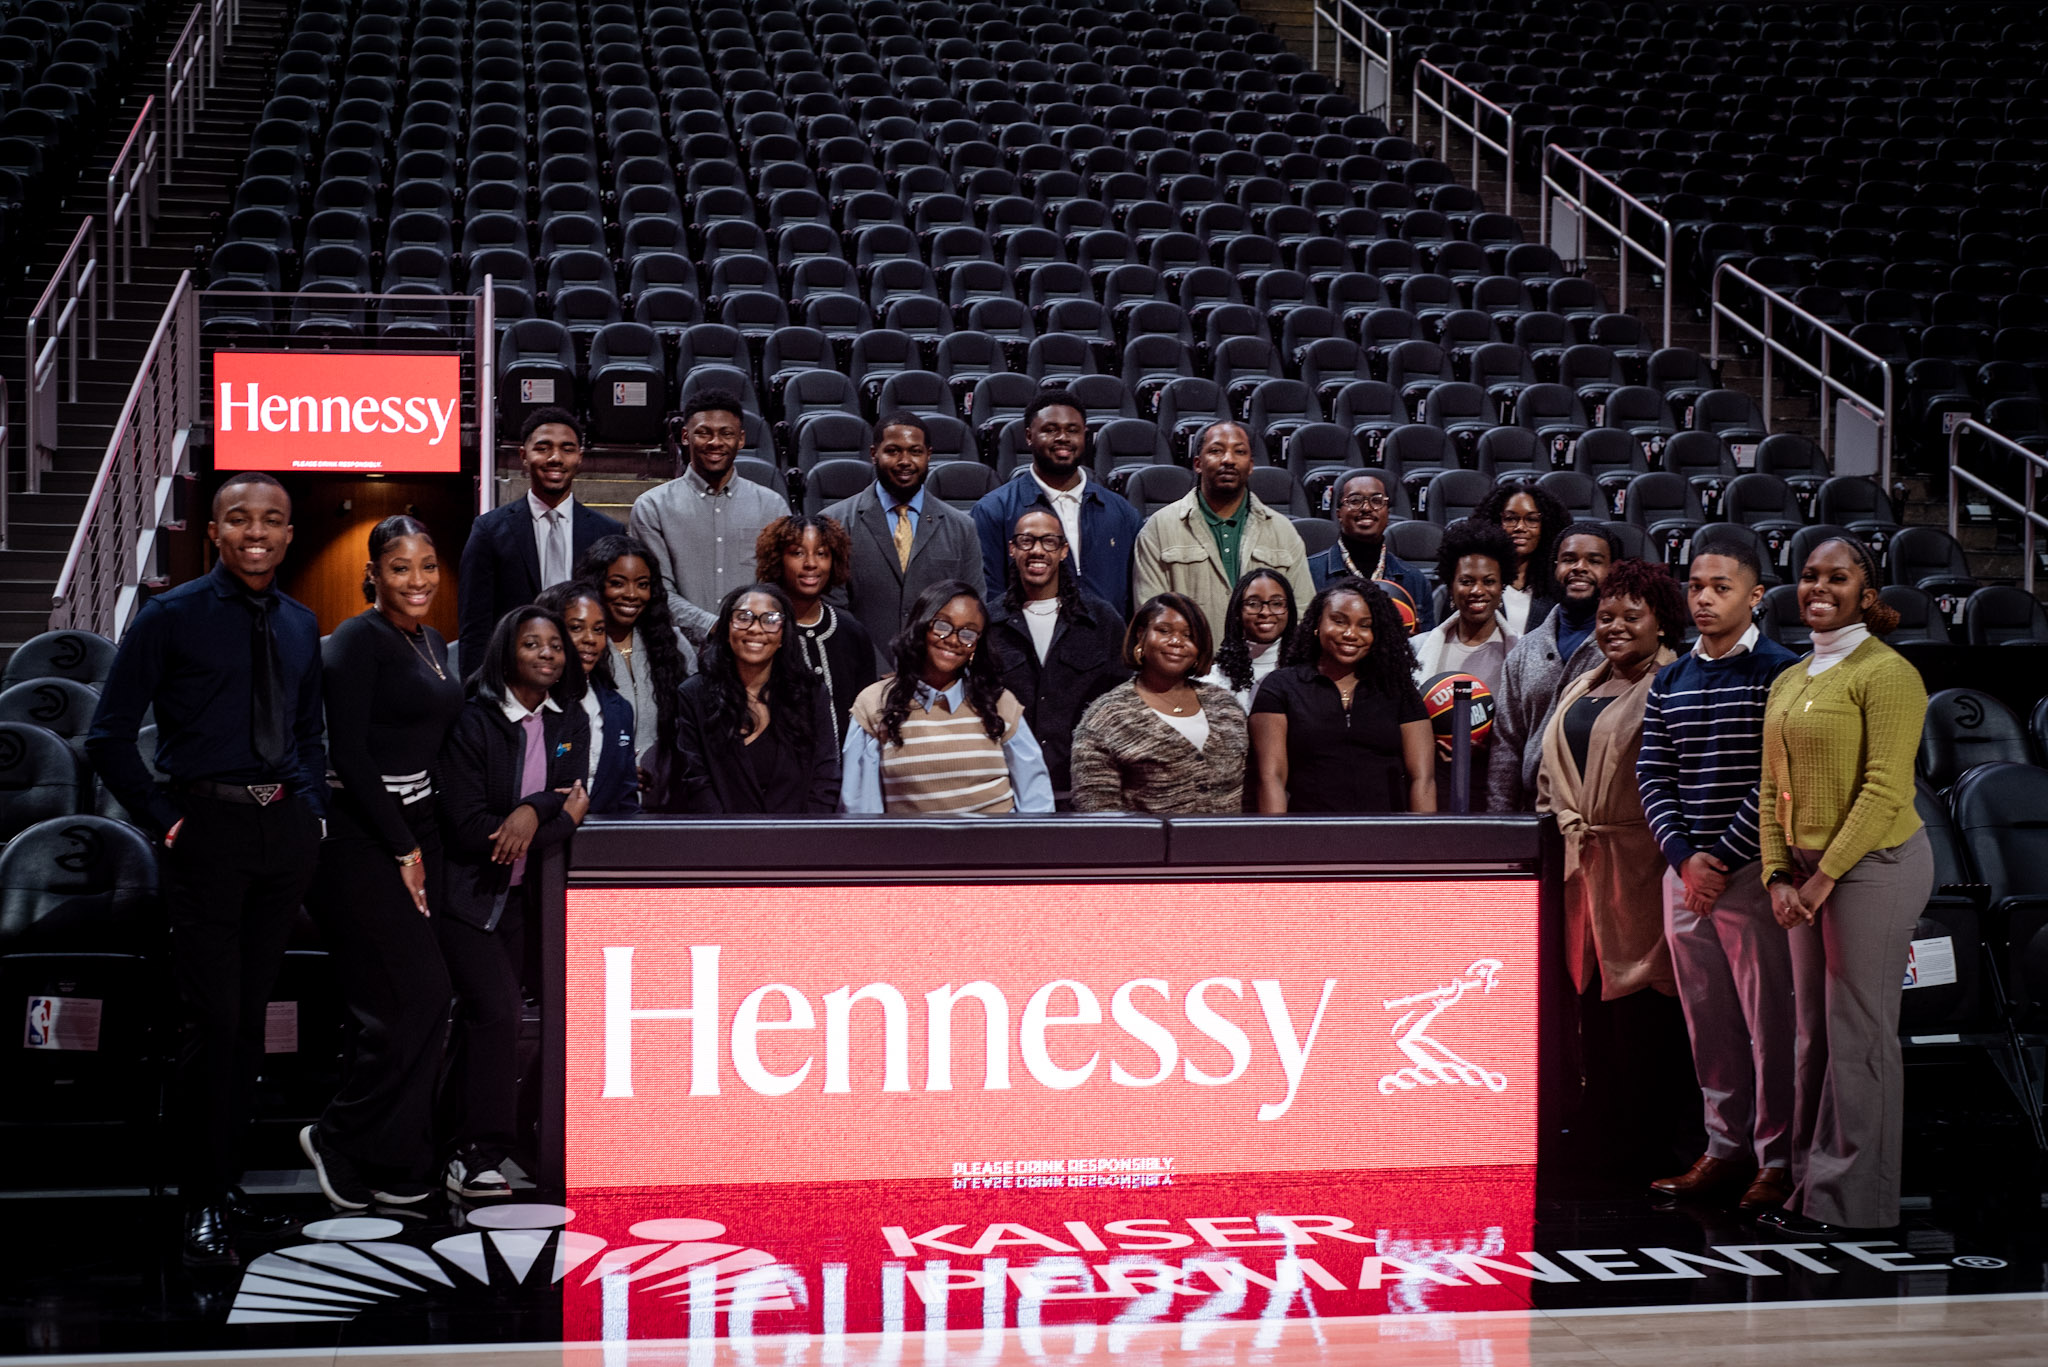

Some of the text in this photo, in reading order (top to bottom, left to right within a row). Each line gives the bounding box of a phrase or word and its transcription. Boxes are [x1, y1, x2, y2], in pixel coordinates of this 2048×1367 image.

[220, 382, 456, 445] Hennessy
[601, 945, 1338, 1121] Hennessy
[953, 1161, 1014, 1175] PLEASE
[1016, 1160, 1065, 1174] DRINK
[881, 1214, 1377, 1257] KAISER
